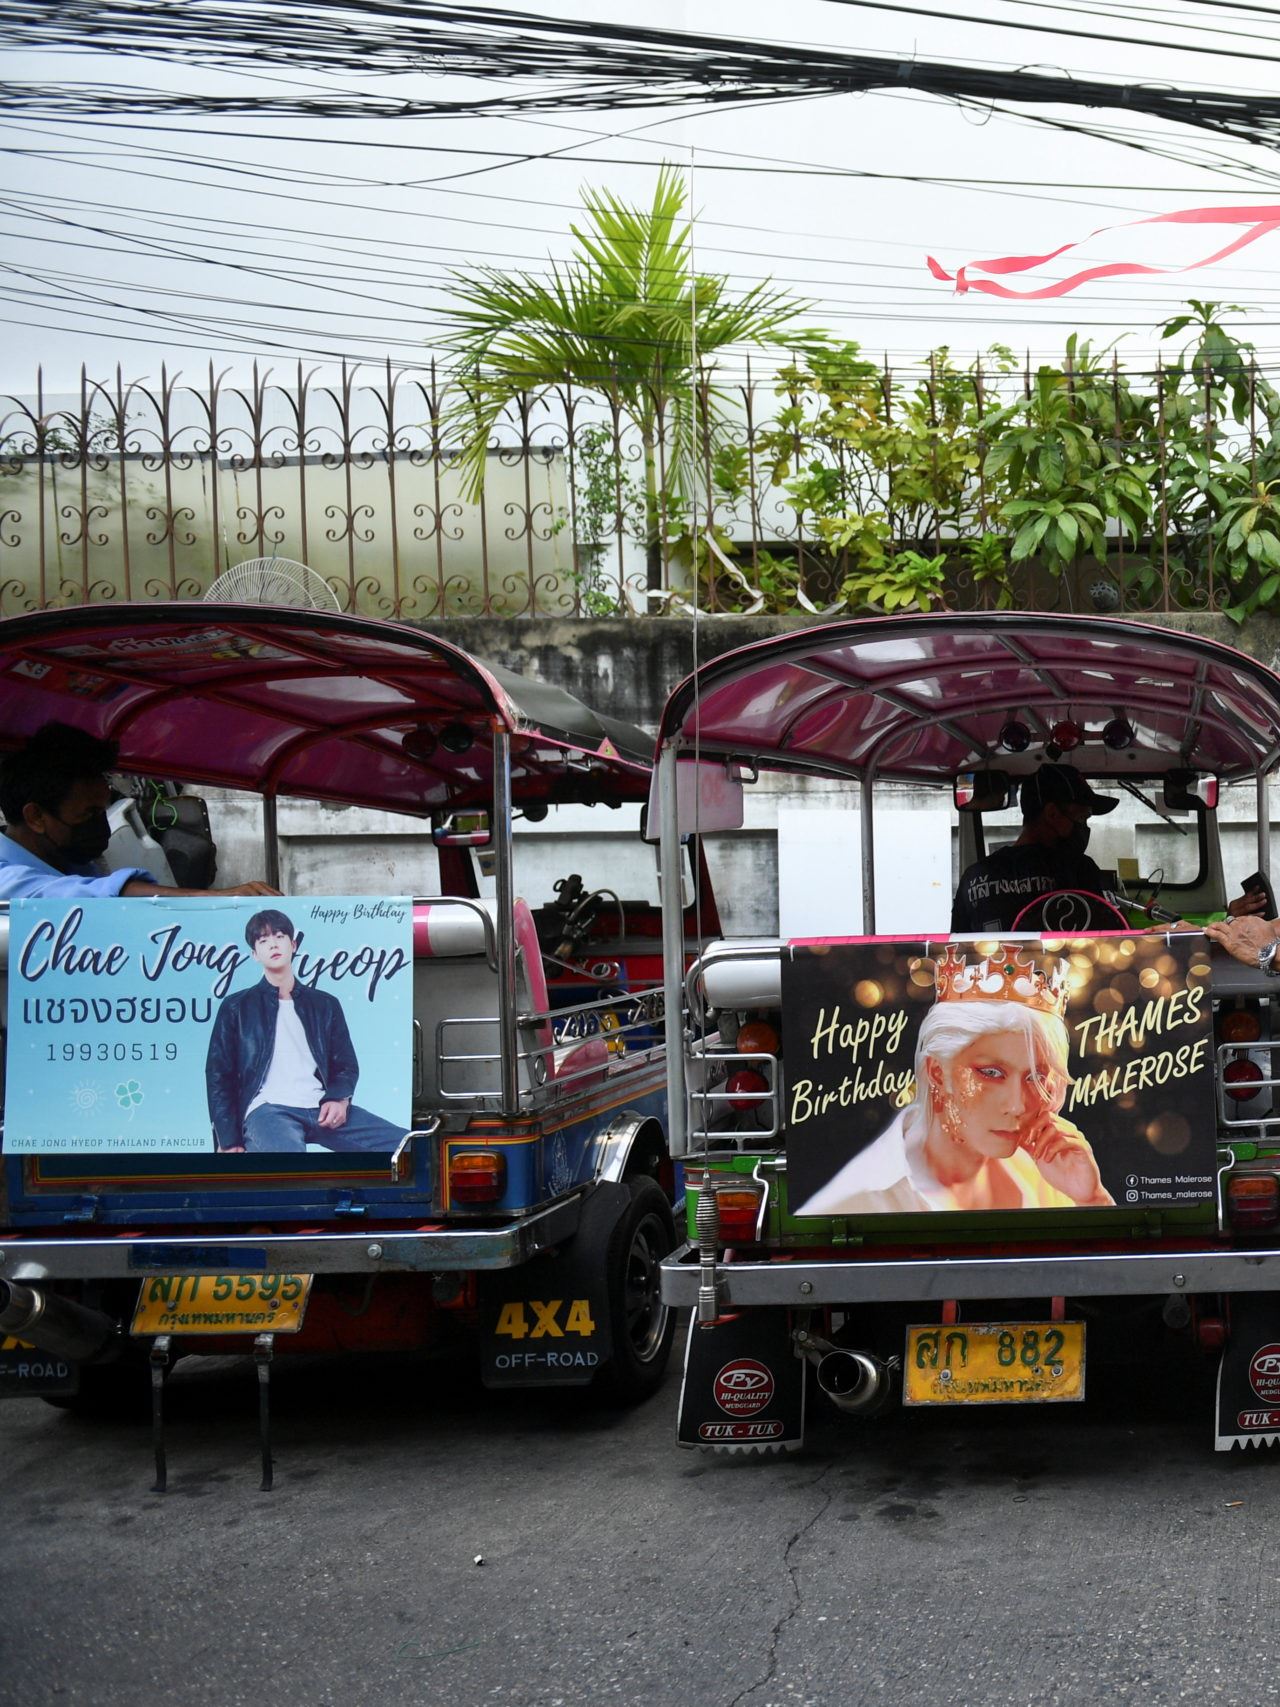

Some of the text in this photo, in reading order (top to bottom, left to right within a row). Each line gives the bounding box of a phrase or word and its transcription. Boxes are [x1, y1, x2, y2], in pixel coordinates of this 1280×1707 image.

[310, 901, 407, 924] Happy Birthday
[19, 906, 411, 1002] Chae Jong yeop
[22, 996, 213, 1024] แชจงฮยอบ
[1074, 986, 1205, 1058] THAMES
[810, 1006, 909, 1064] Happy
[46, 1042, 178, 1062] 19930519
[1068, 1039, 1209, 1112] MALEROSE
[790, 1059, 916, 1125] Birthday
[11, 1138, 206, 1147] CHAE JONG HYEOP THAILAND FANCLUB
[1140, 1175, 1212, 1184] Thames Malerose
[997, 1329, 1066, 1367] 882
[495, 1352, 599, 1369] OFF-ROAD
[720, 1392, 771, 1401] HI-QUALITY
[705, 1425, 736, 1436] TUK
[748, 1423, 777, 1435] TUK
[1244, 1413, 1272, 1426] TUK
